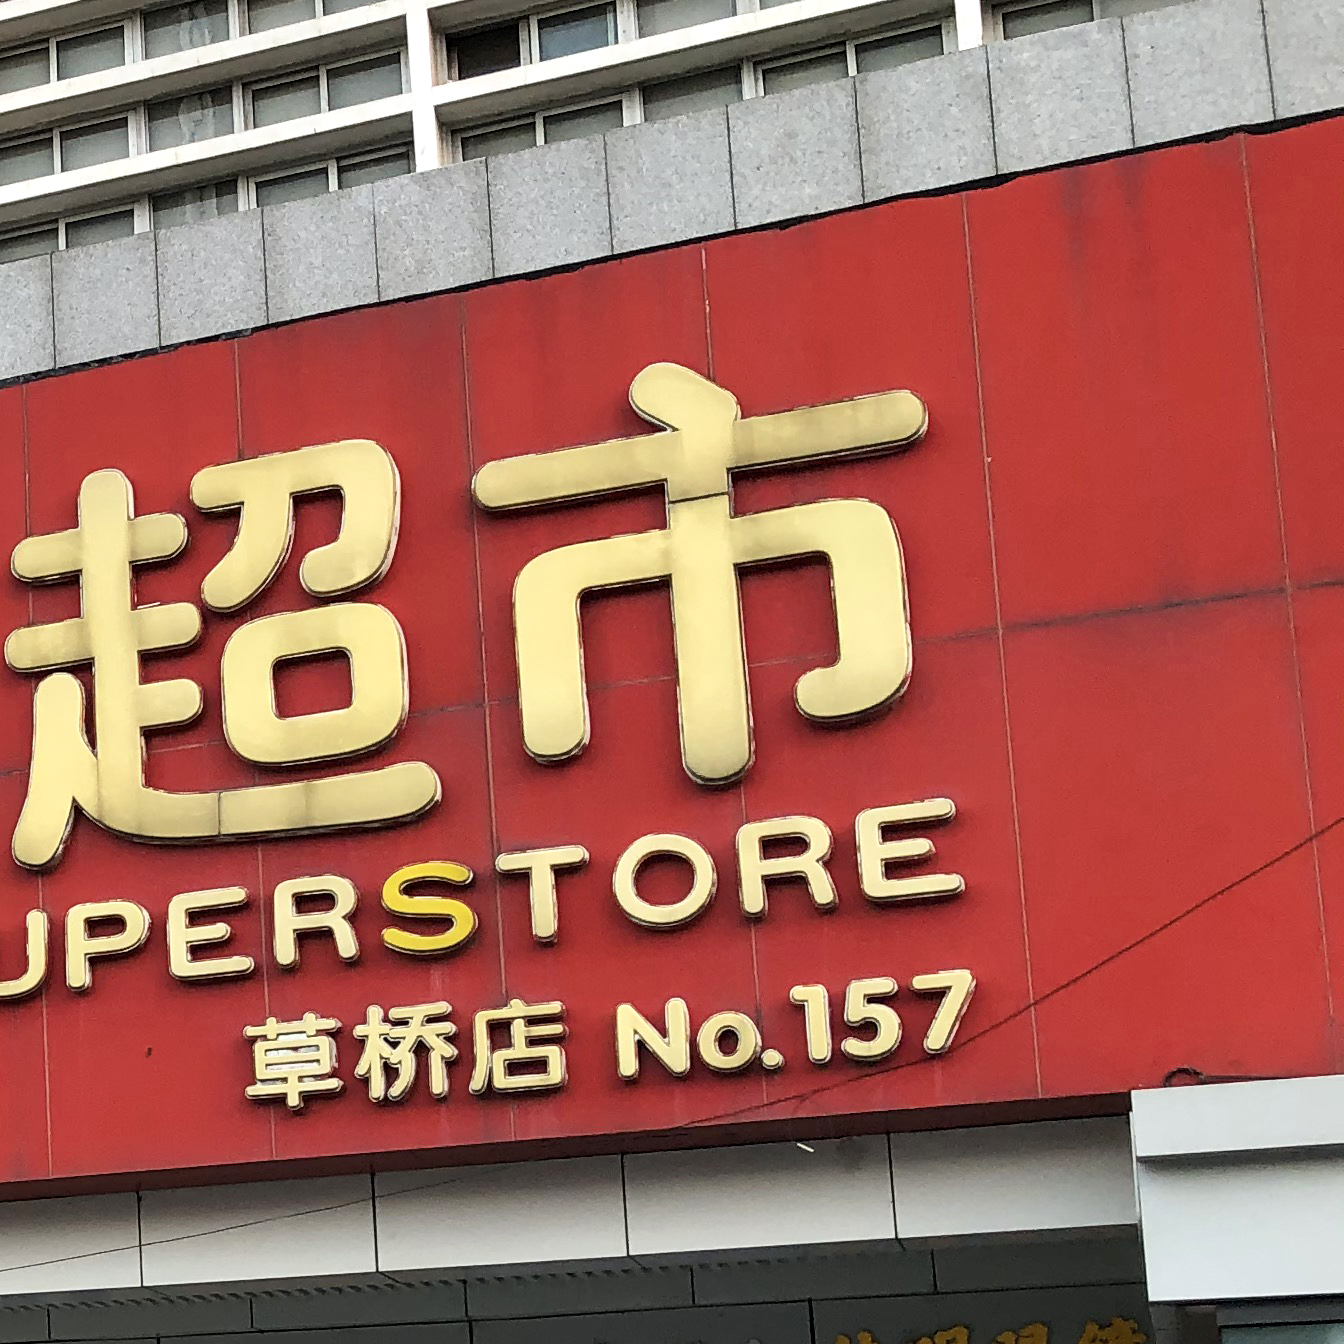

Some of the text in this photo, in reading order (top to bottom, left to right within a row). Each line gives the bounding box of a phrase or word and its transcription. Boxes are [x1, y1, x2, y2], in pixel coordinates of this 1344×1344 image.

[245, 969, 977, 1111] 草桥店 No.157
